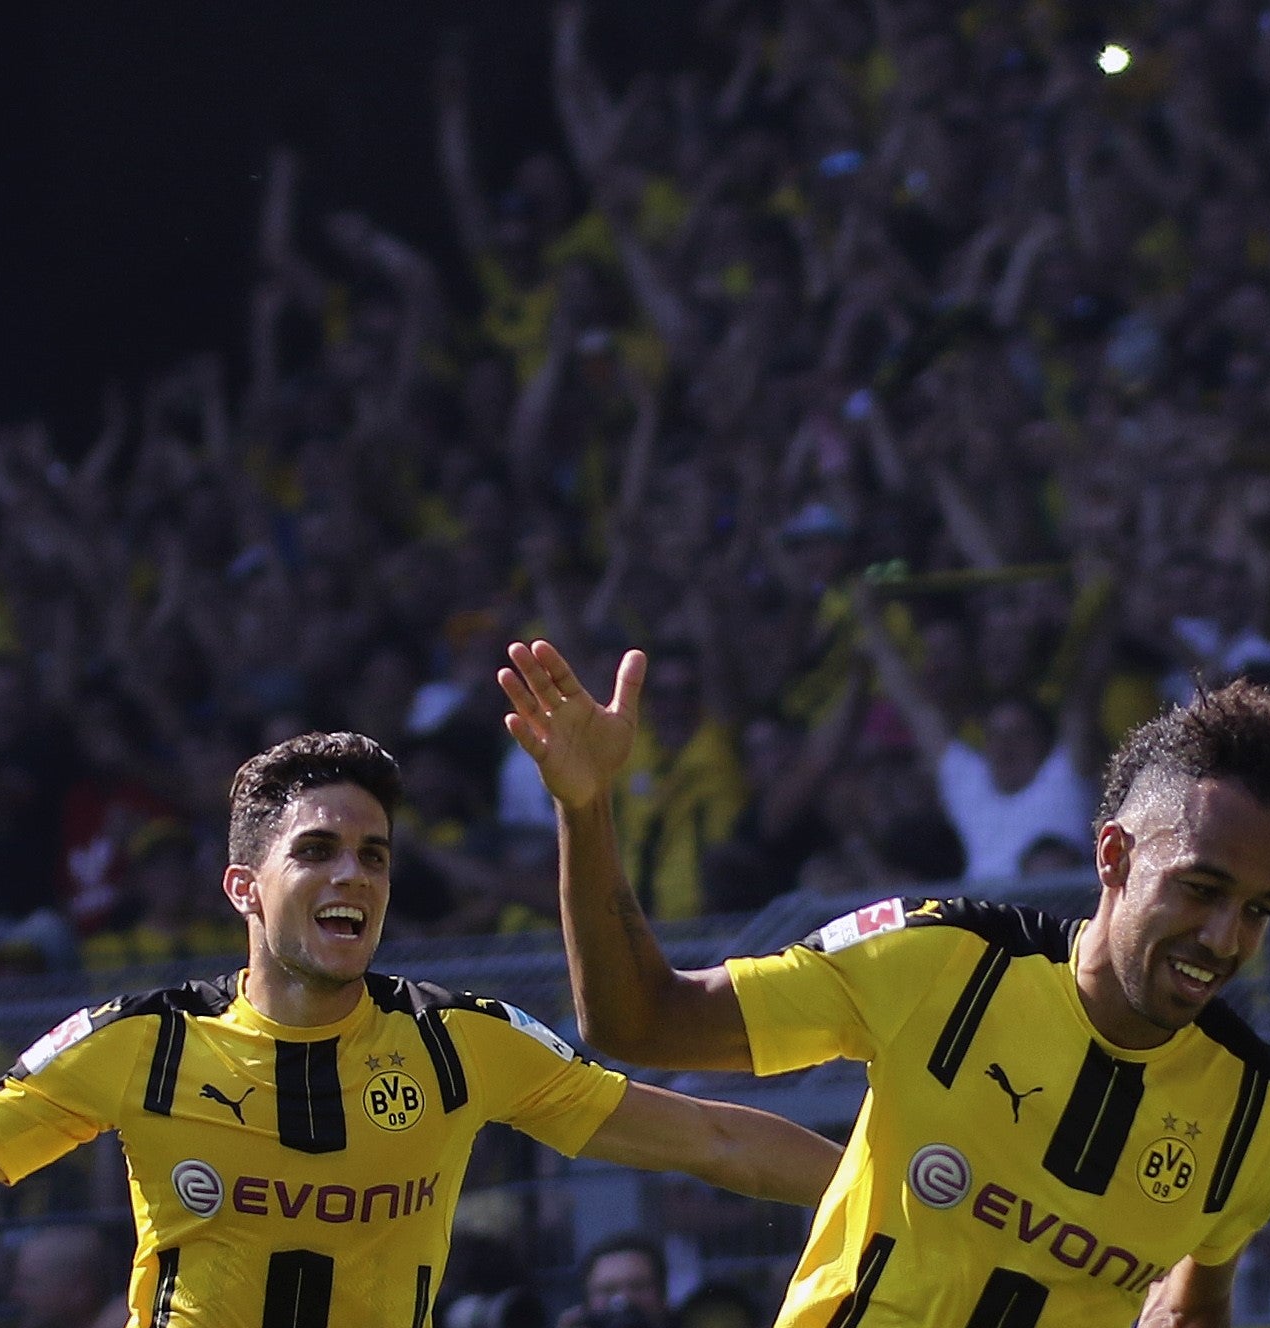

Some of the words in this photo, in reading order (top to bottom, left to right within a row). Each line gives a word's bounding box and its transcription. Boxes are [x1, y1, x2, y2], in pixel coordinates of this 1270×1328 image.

[370, 1075, 419, 1116] BVB
[388, 1111, 407, 1126] 09
[1143, 1142, 1193, 1189] BVB
[232, 1171, 441, 1224] EVONIK
[1152, 1181, 1171, 1198] 09
